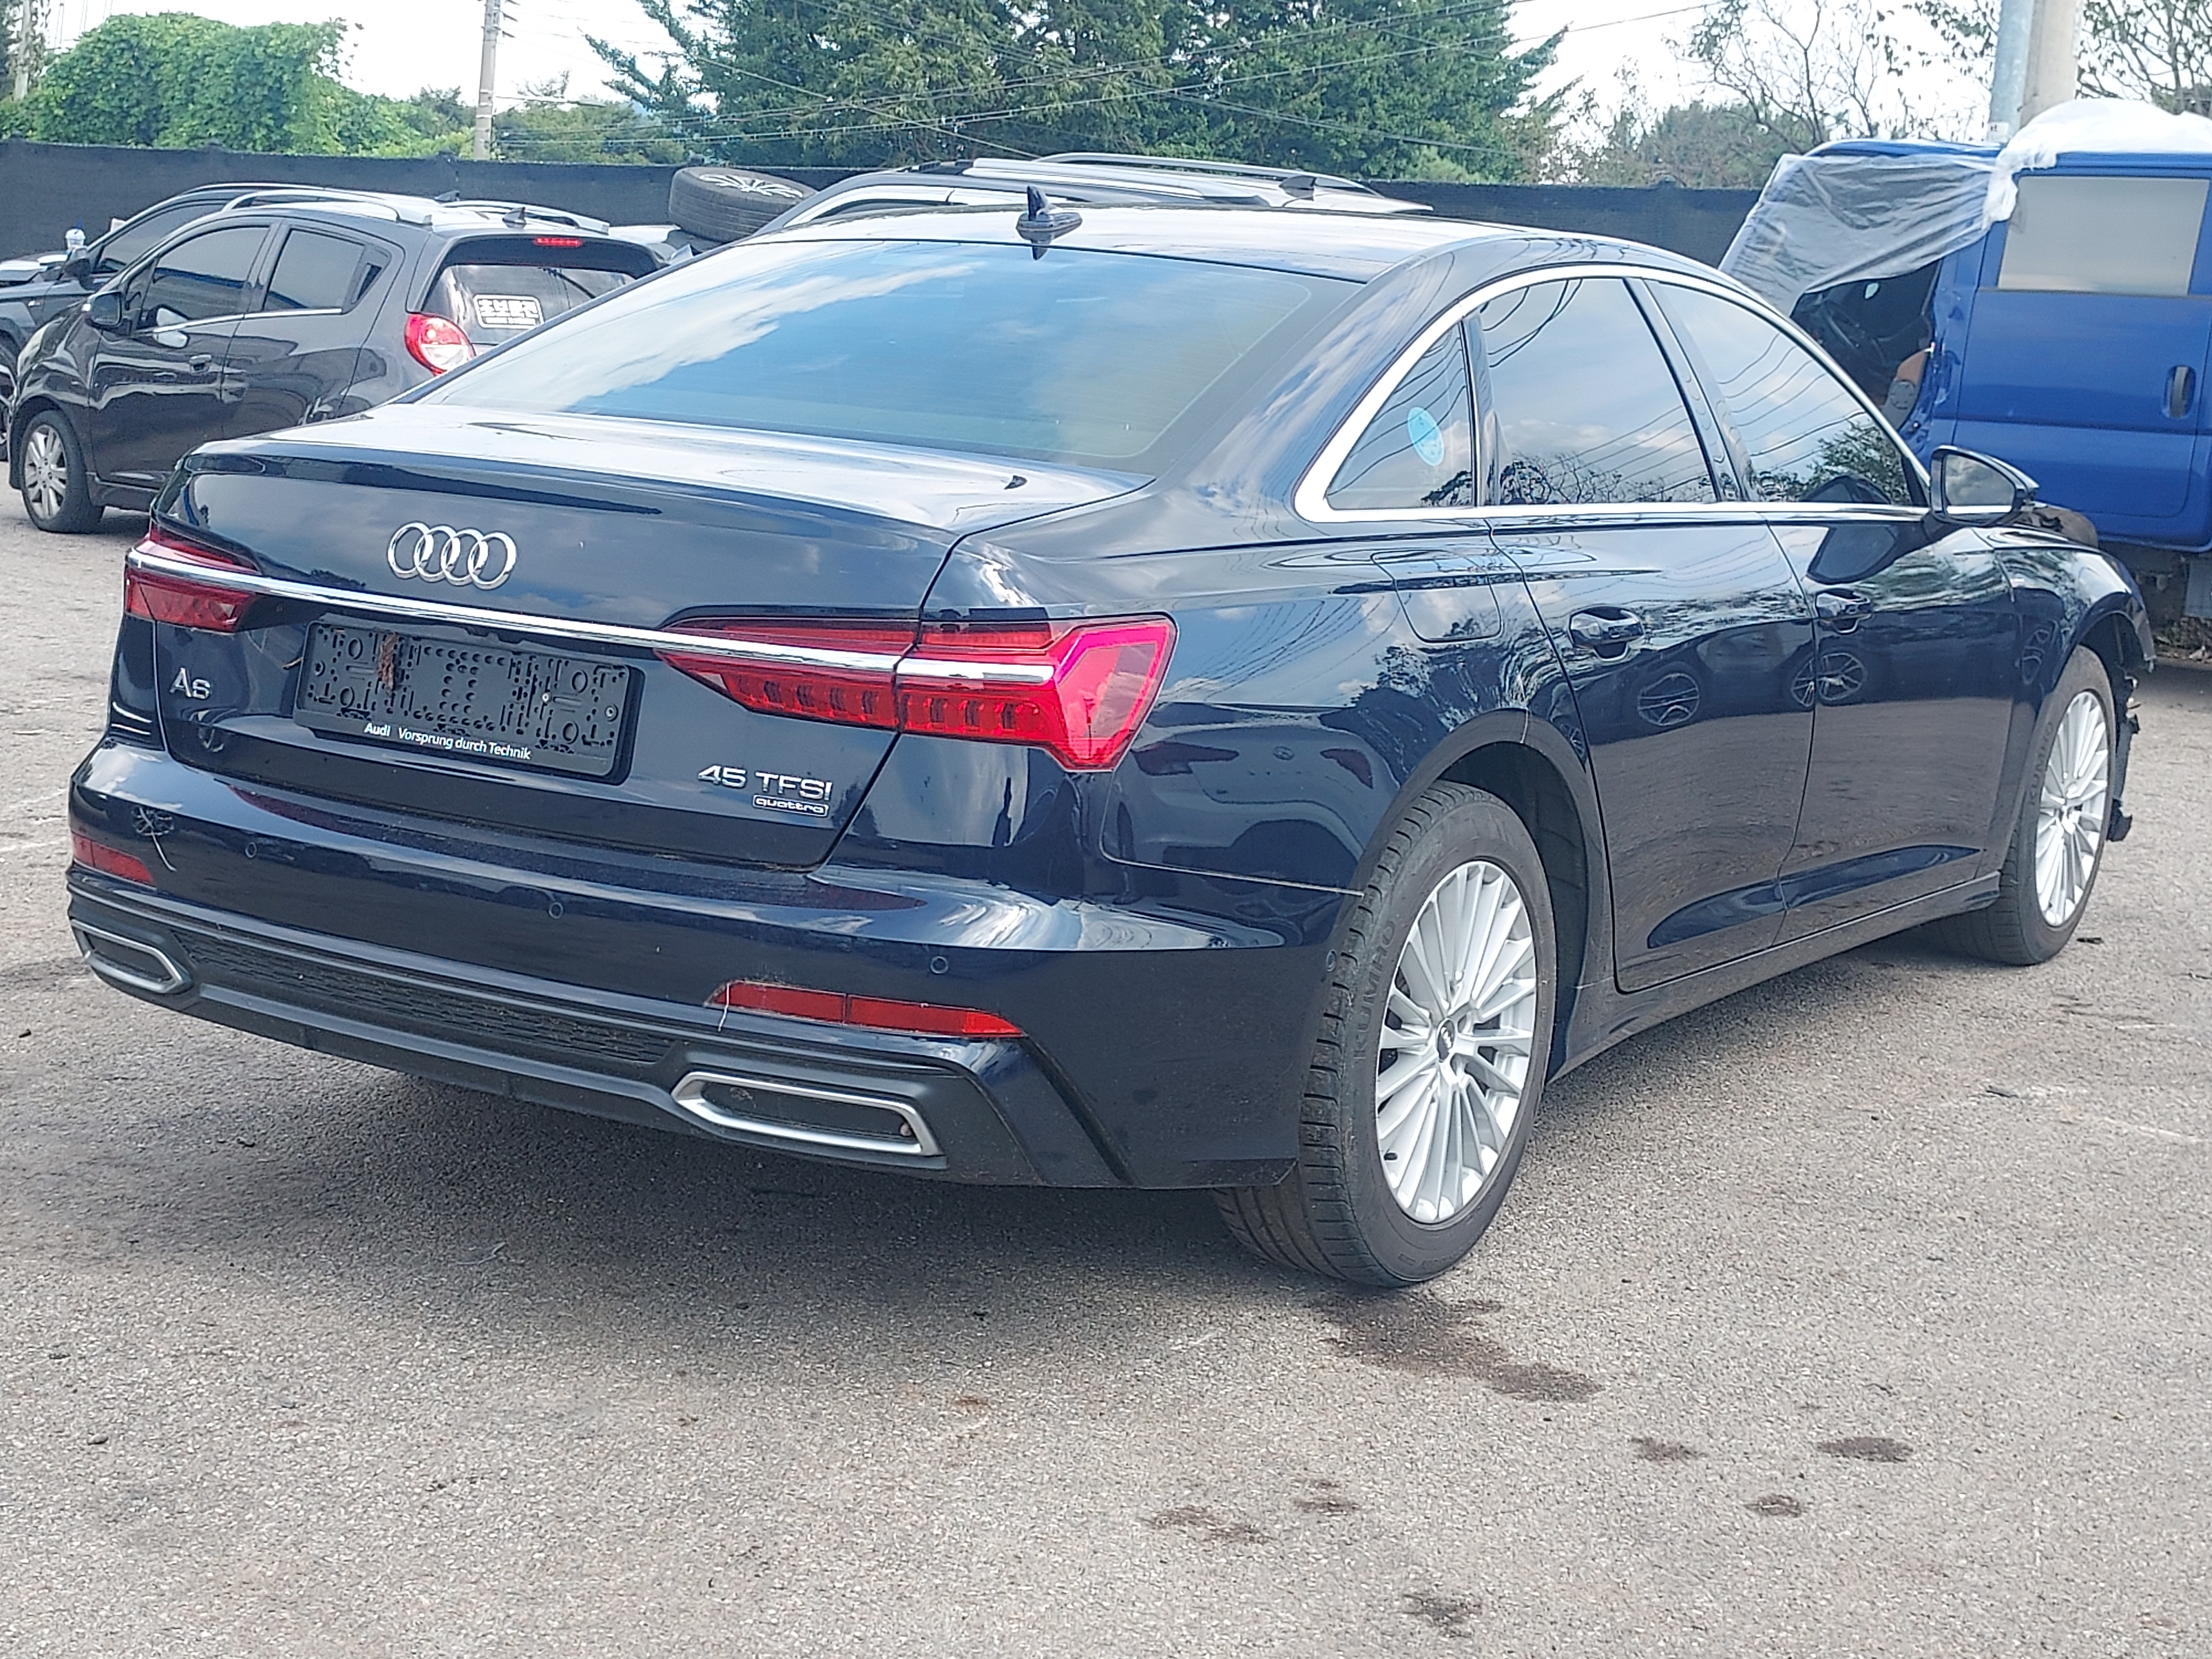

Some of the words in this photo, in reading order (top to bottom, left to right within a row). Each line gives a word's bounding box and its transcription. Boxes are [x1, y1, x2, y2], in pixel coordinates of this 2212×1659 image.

[170, 667, 211, 700] A6
[364, 723, 390, 737] Audi
[398, 727, 453, 749] Vorsprung
[455, 737, 487, 753] durch
[488, 742, 531, 759] Technik
[697, 765, 746, 788] 45
[755, 771, 832, 800] TFSI
[755, 797, 825, 814] quattro
